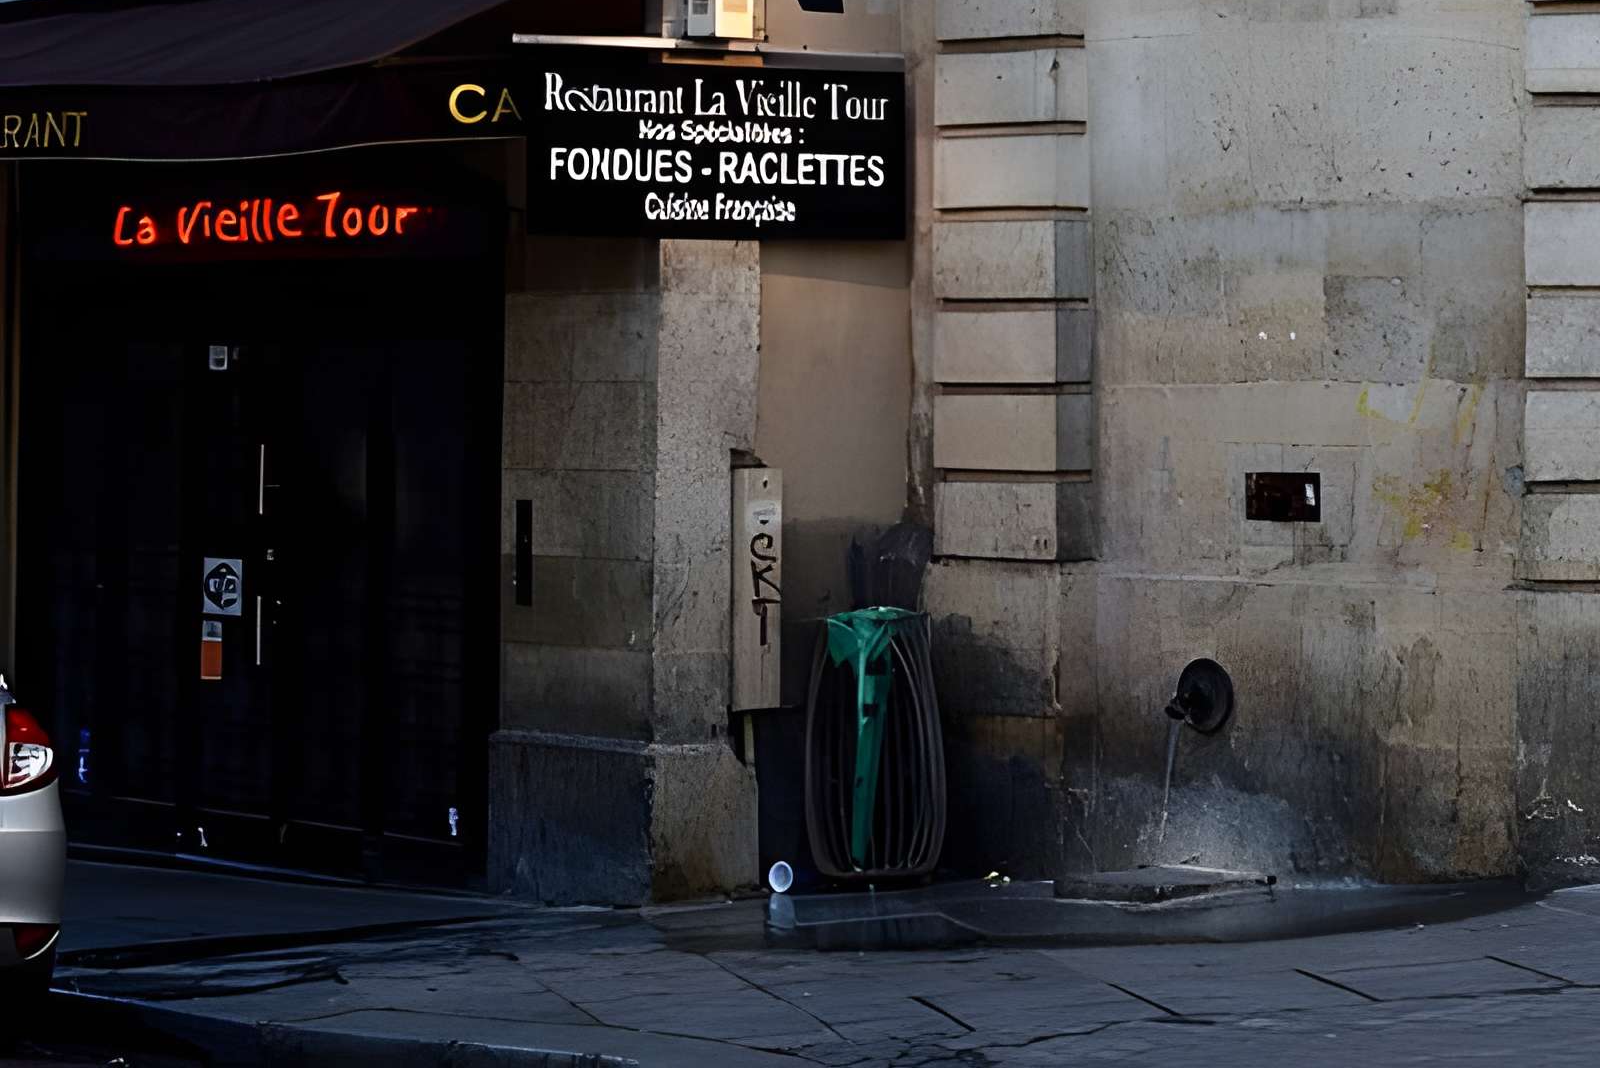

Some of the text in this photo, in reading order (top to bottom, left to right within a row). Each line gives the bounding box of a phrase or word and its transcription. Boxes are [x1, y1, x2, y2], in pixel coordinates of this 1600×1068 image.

[544, 72, 890, 122] Restaurant La Vieille Tour
[549, 146, 693, 184] FONDUES
[718, 150, 886, 188] RACLETTES
[112, 190, 422, 246] La Vieille Tour
